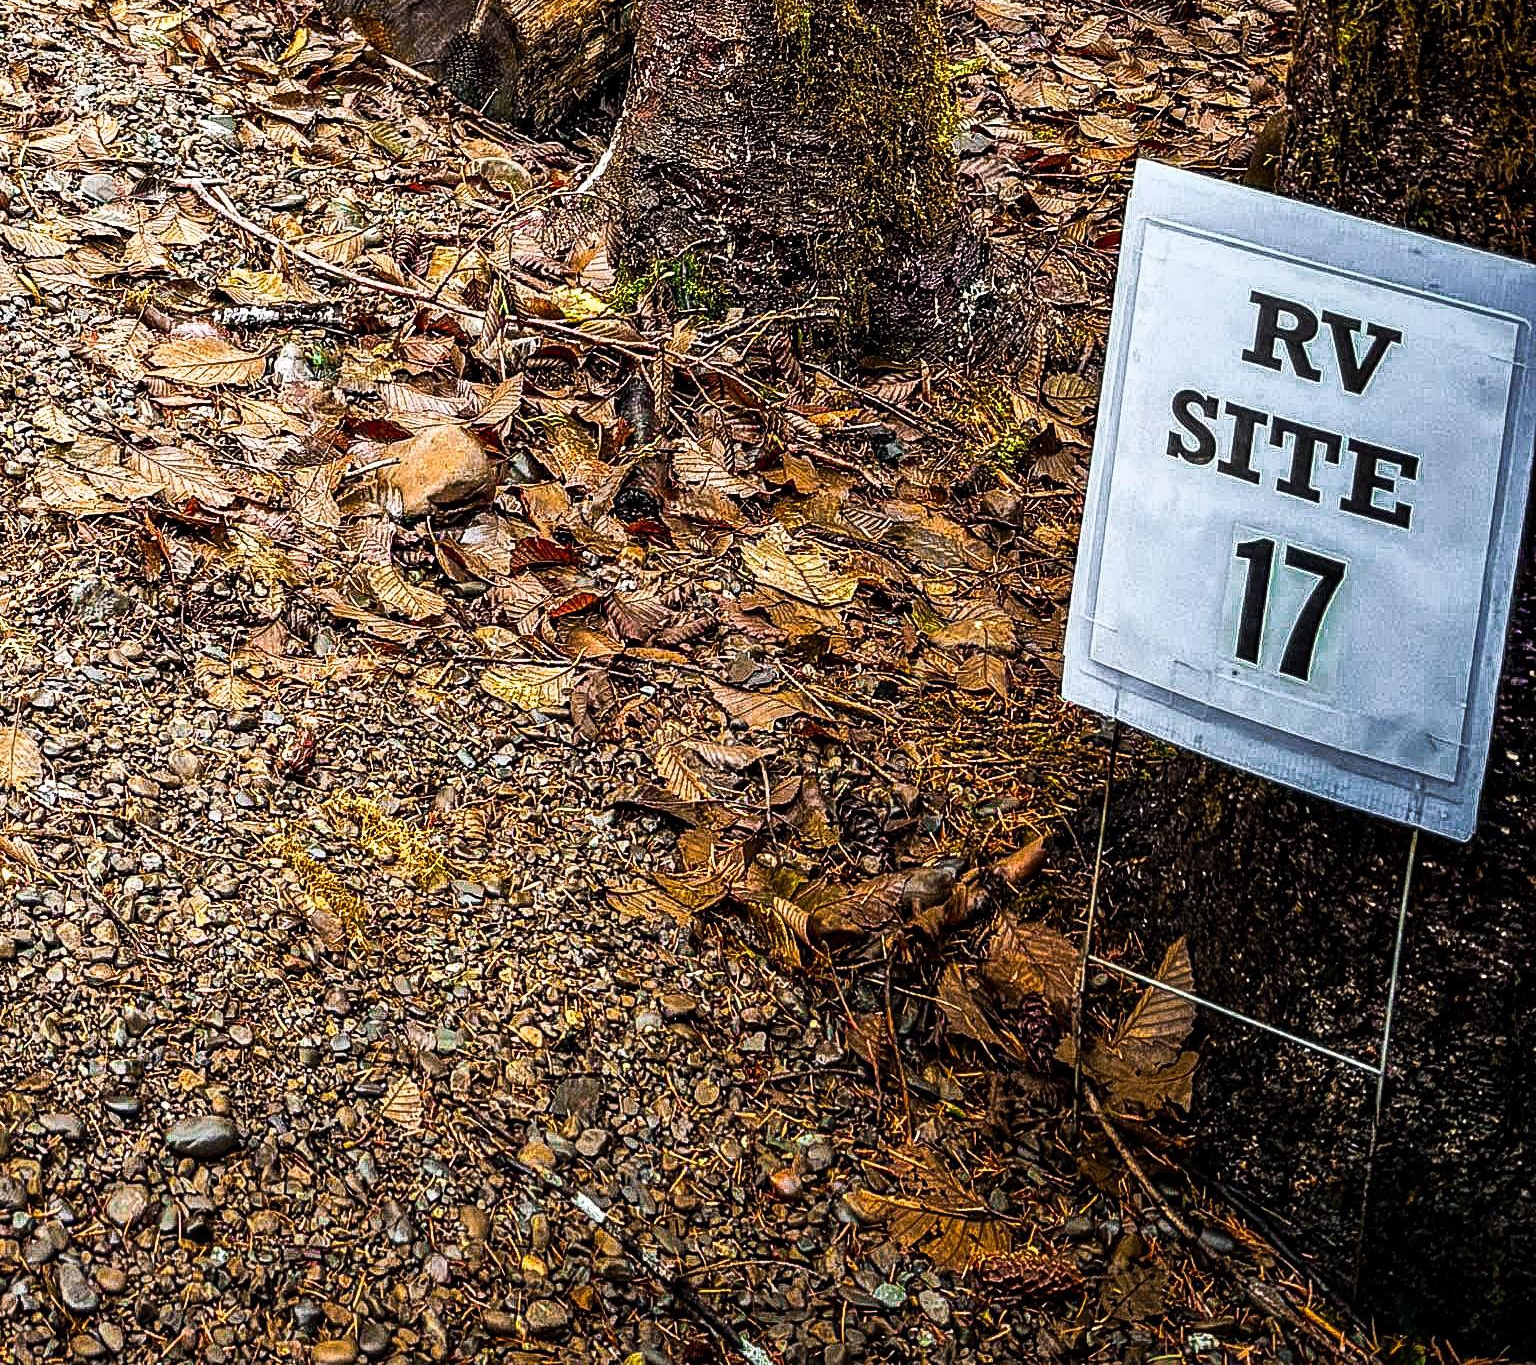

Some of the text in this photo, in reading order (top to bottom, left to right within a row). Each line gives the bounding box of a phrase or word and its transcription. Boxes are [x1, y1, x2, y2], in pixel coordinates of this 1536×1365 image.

[1241, 289, 1404, 396] RV
[1166, 389, 1420, 530] SITE
[1234, 537, 1347, 683] 17
